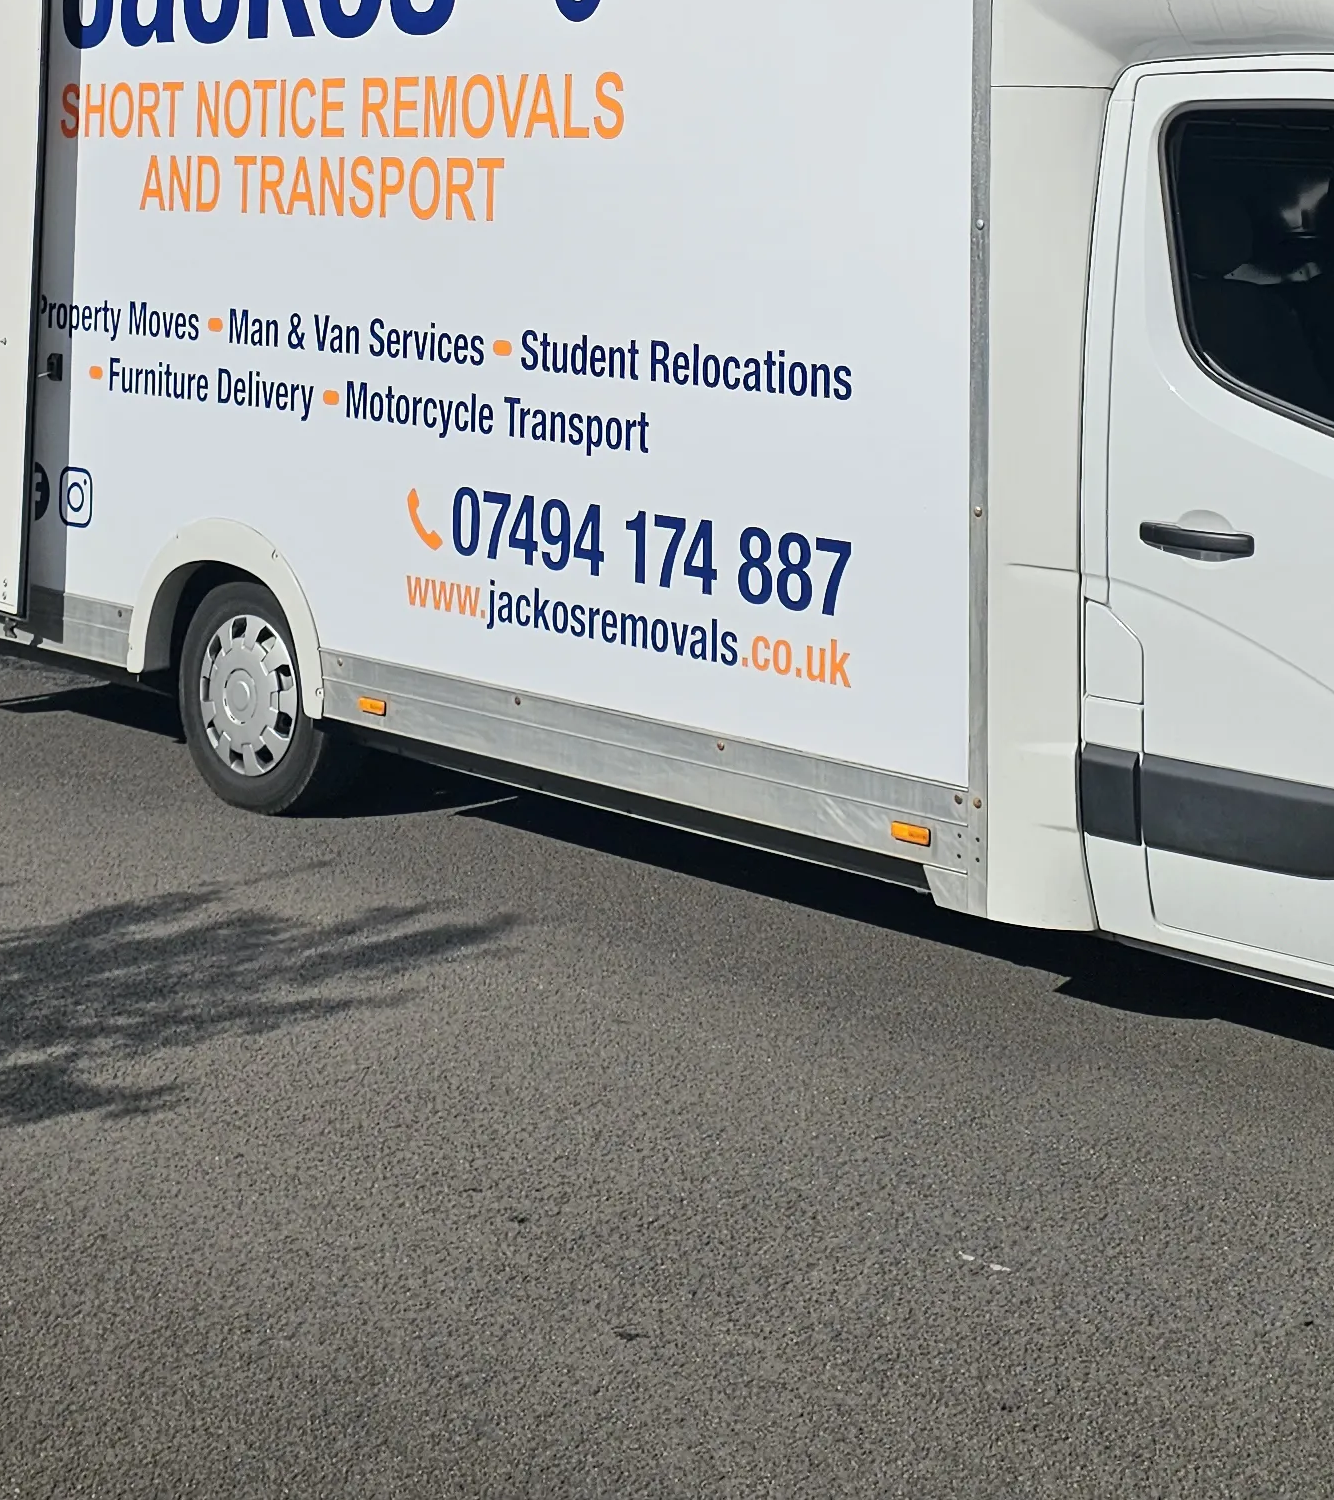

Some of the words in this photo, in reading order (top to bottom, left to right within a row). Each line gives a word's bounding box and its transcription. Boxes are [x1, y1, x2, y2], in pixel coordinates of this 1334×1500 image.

[59, 79, 185, 140] SHORT
[196, 77, 346, 139] NOTICE
[361, 71, 625, 140] REMOVALS
[140, 155, 221, 212] AND
[234, 155, 505, 221] TRANSPORT
[128, 300, 200, 341] Moves
[228, 308, 280, 349] Man
[287, 312, 307, 350] &
[314, 314, 360, 356] Van
[369, 317, 485, 367] Services
[520, 329, 640, 381] Student
[650, 339, 853, 402] Relocations
[109, 357, 209, 403] Furniture
[217, 367, 315, 422] Delivery
[345, 380, 494, 439] Motorcycle
[503, 395, 650, 457] Transport
[452, 486, 605, 577] 07494
[624, 510, 718, 597] 174
[737, 526, 853, 617] 887
[405, 571, 852, 688] www.jackosremovals.co.uk
